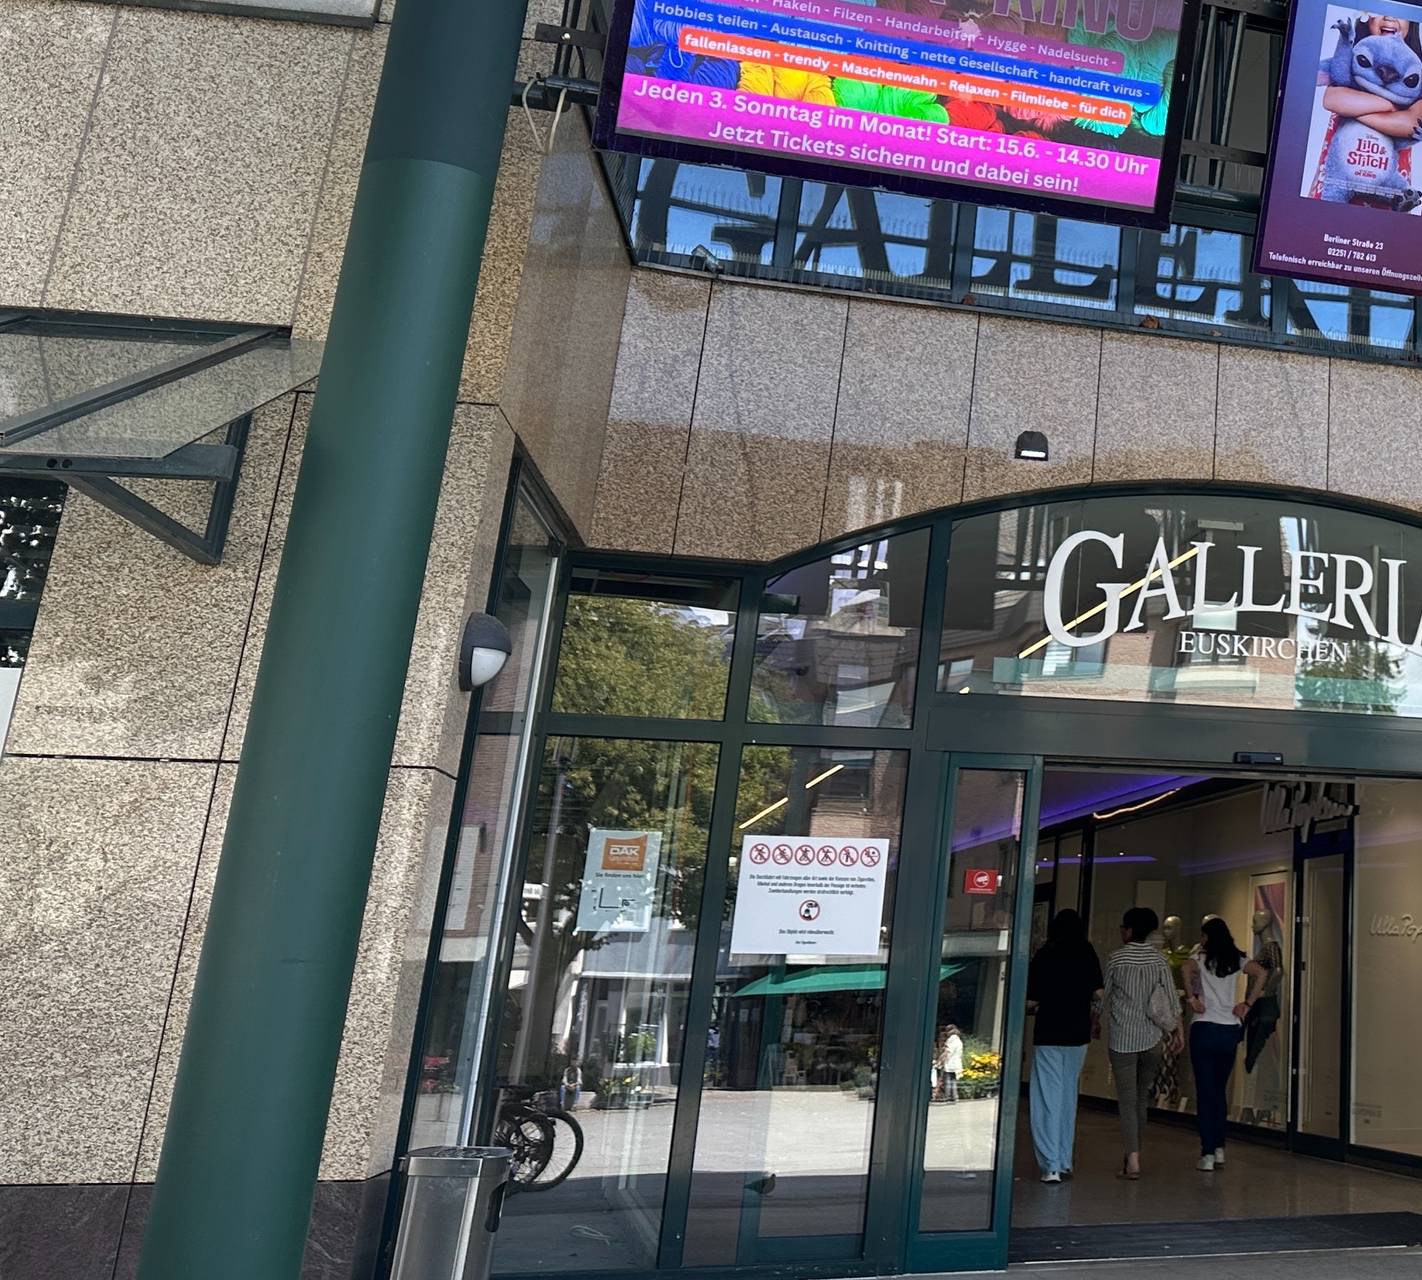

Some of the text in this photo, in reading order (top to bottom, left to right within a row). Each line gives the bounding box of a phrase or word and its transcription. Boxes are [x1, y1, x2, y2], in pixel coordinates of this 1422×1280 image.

[654, 2, 713, 23] Hobbies
[717, 11, 758, 30] teilen
[770, 22, 843, 45] Austausch
[855, 38, 909, 59] Knitting
[920, 51, 956, 66] nette
[959, 57, 1039, 80] Gesellschaft
[1049, 72, 1109, 90] handcraft
[1113, 84, 1142, 98] virus
[834, 7, 872, 24] Filzen
[885, 17, 976, 41] Handarbeiten
[987, 35, 1027, 52] Hygge
[1038, 44, 1108, 67] Nadelsucht
[685, 34, 771, 59] fallenlassen
[783, 52, 830, 72] trendy
[842, 61, 937, 88] Maschenwahn
[949, 80, 999, 98] Relaxen
[1011, 90, 1068, 110] Filmliebe
[1079, 101, 1097, 115] für
[1100, 103, 1126, 120] dich
[634, 80, 704, 105] Jeden
[709, 91, 727, 110] 3.
[733, 95, 822, 128] Sonntag
[828, 108, 852, 129] im
[859, 115, 931, 141] Monat!
[937, 127, 991, 151] Start:
[997, 138, 1040, 159] 15.6.
[1057, 148, 1109, 170] 14.30
[1115, 156, 1149, 176] Uhr
[708, 122, 1079, 192] Jetzt Tickets sichern und dabei sein!
[1269, 252, 1306, 265] Telefonisch
[1307, 258, 1342, 271] erreichbar
[1344, 264, 1352, 272] zu
[1354, 266, 1380, 276] unseren
[1324, 233, 1350, 245] Berliner
[1375, 242, 1384, 250] 23
[1327, 248, 1347, 258] 02251
[1353, 251, 1365, 261] 782
[1179, 631, 1348, 664] EUSKIRCHEN
[609, 844, 640, 856] DAK
